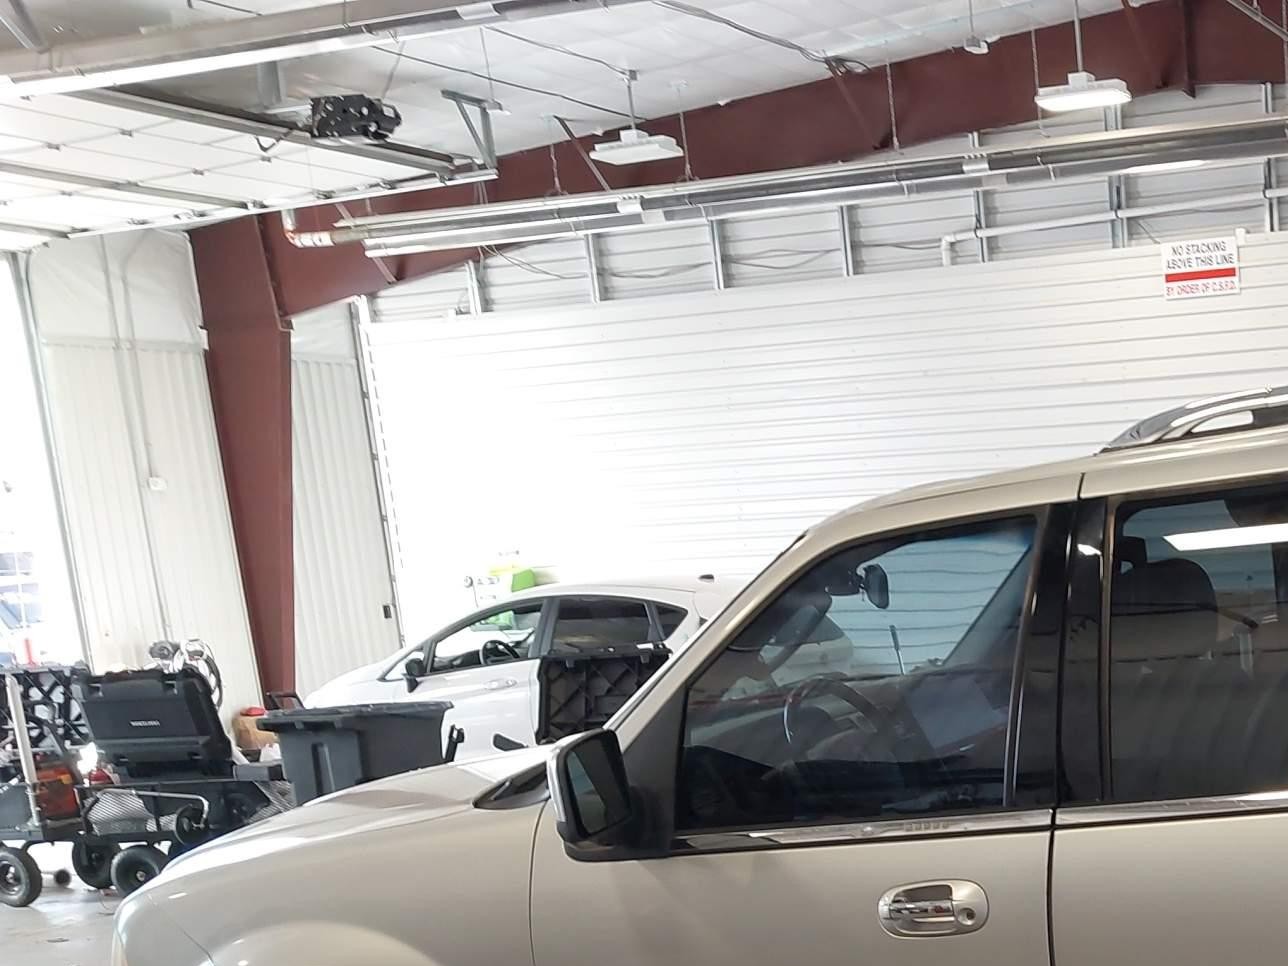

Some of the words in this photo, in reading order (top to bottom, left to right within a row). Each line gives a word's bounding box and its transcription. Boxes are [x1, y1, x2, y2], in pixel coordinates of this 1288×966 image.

[1171, 245, 1183, 256] NO
[1186, 240, 1226, 255] STACKING
[1167, 257, 1192, 270] ABOVE
[1195, 255, 1213, 267] THIS
[1215, 253, 1234, 265] LINE
